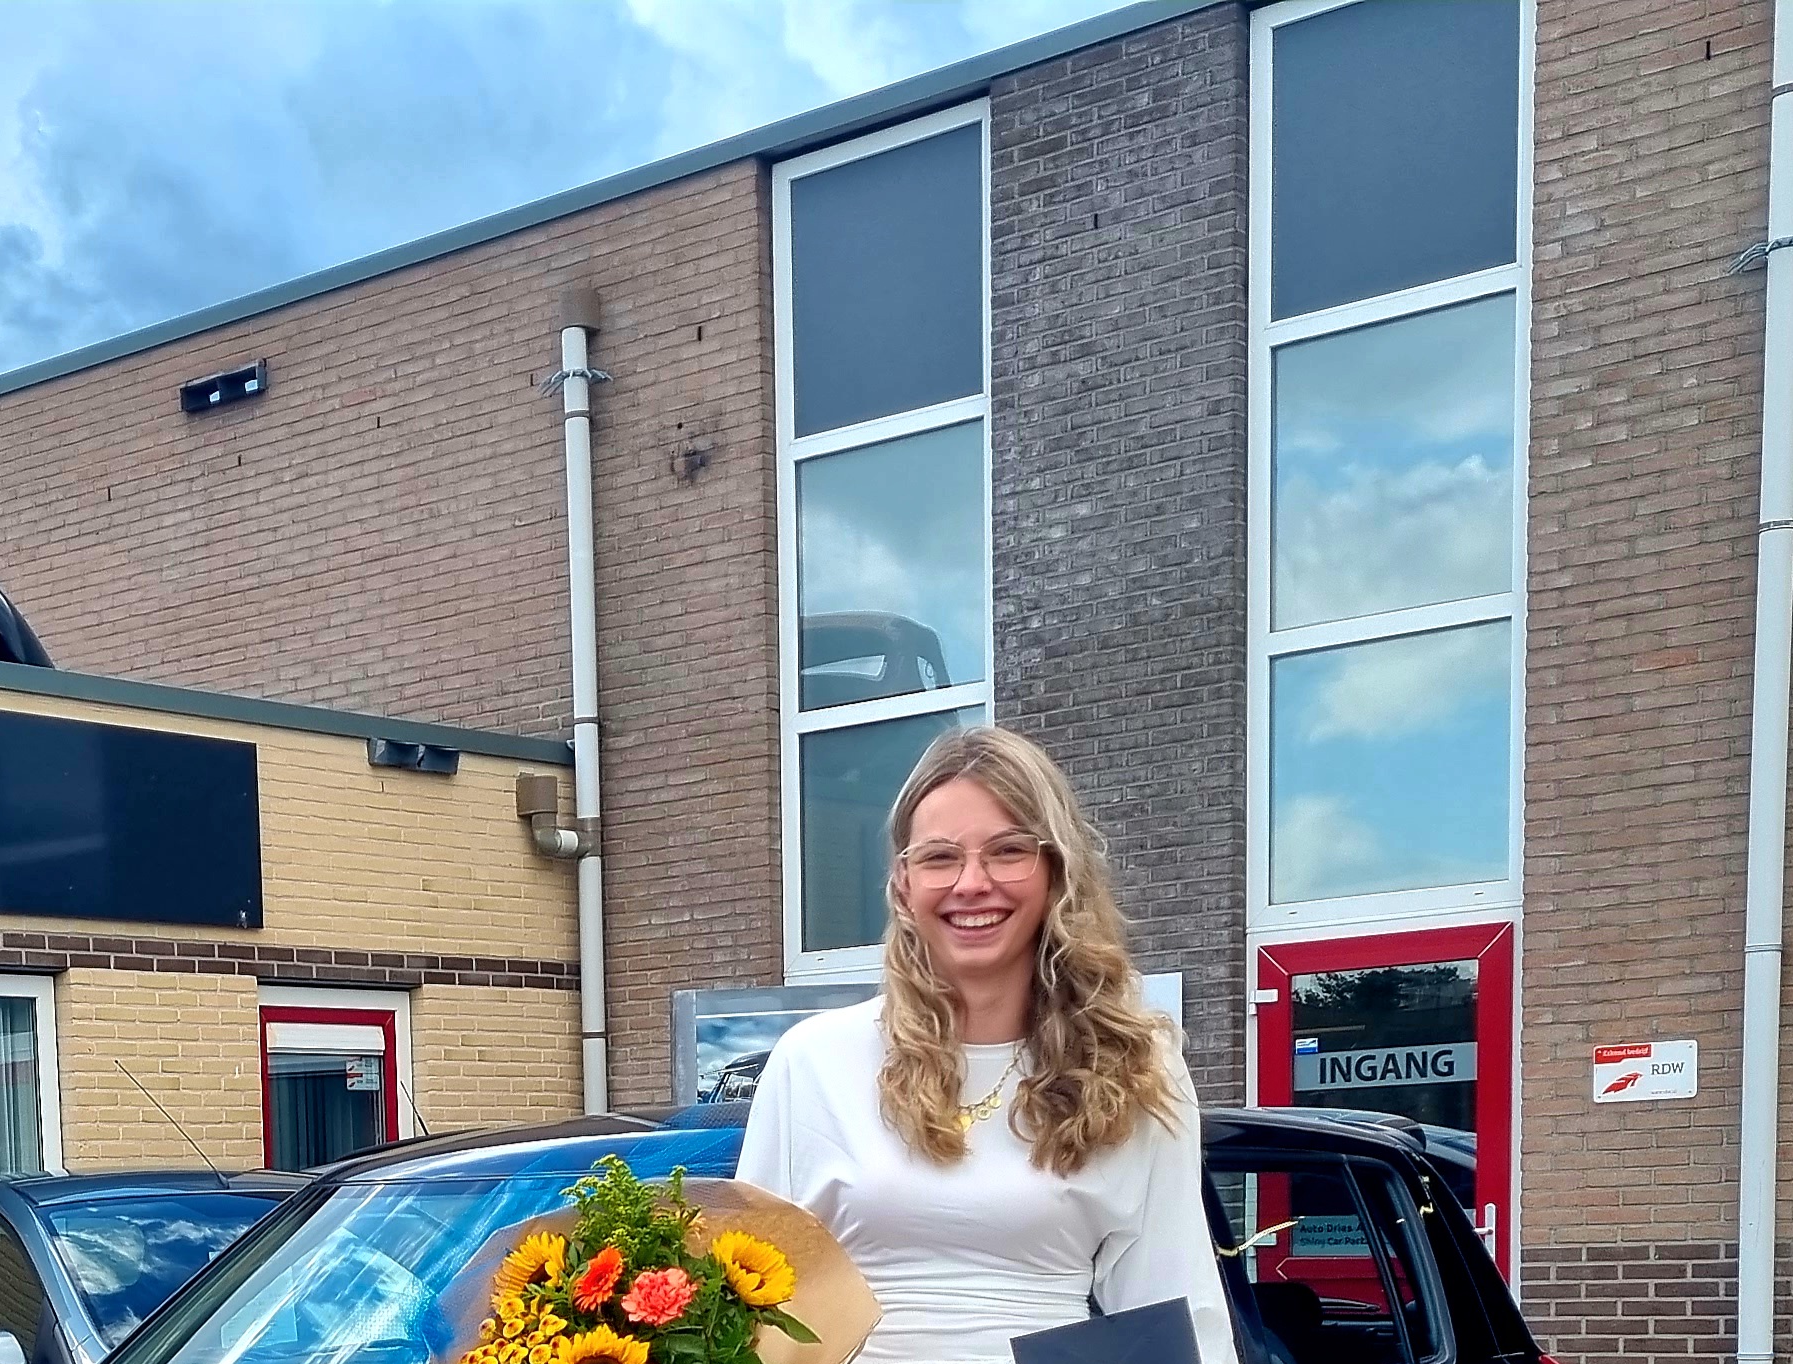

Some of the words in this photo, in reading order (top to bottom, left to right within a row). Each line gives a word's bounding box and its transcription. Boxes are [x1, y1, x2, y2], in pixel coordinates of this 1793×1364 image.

[1319, 1049, 1455, 1085] INGANG
[1651, 1061, 1685, 1075] RDW
[1299, 1224, 1324, 1233] Auto
[1326, 1223, 1353, 1233] Dries
[1327, 1237, 1343, 1245] Car
